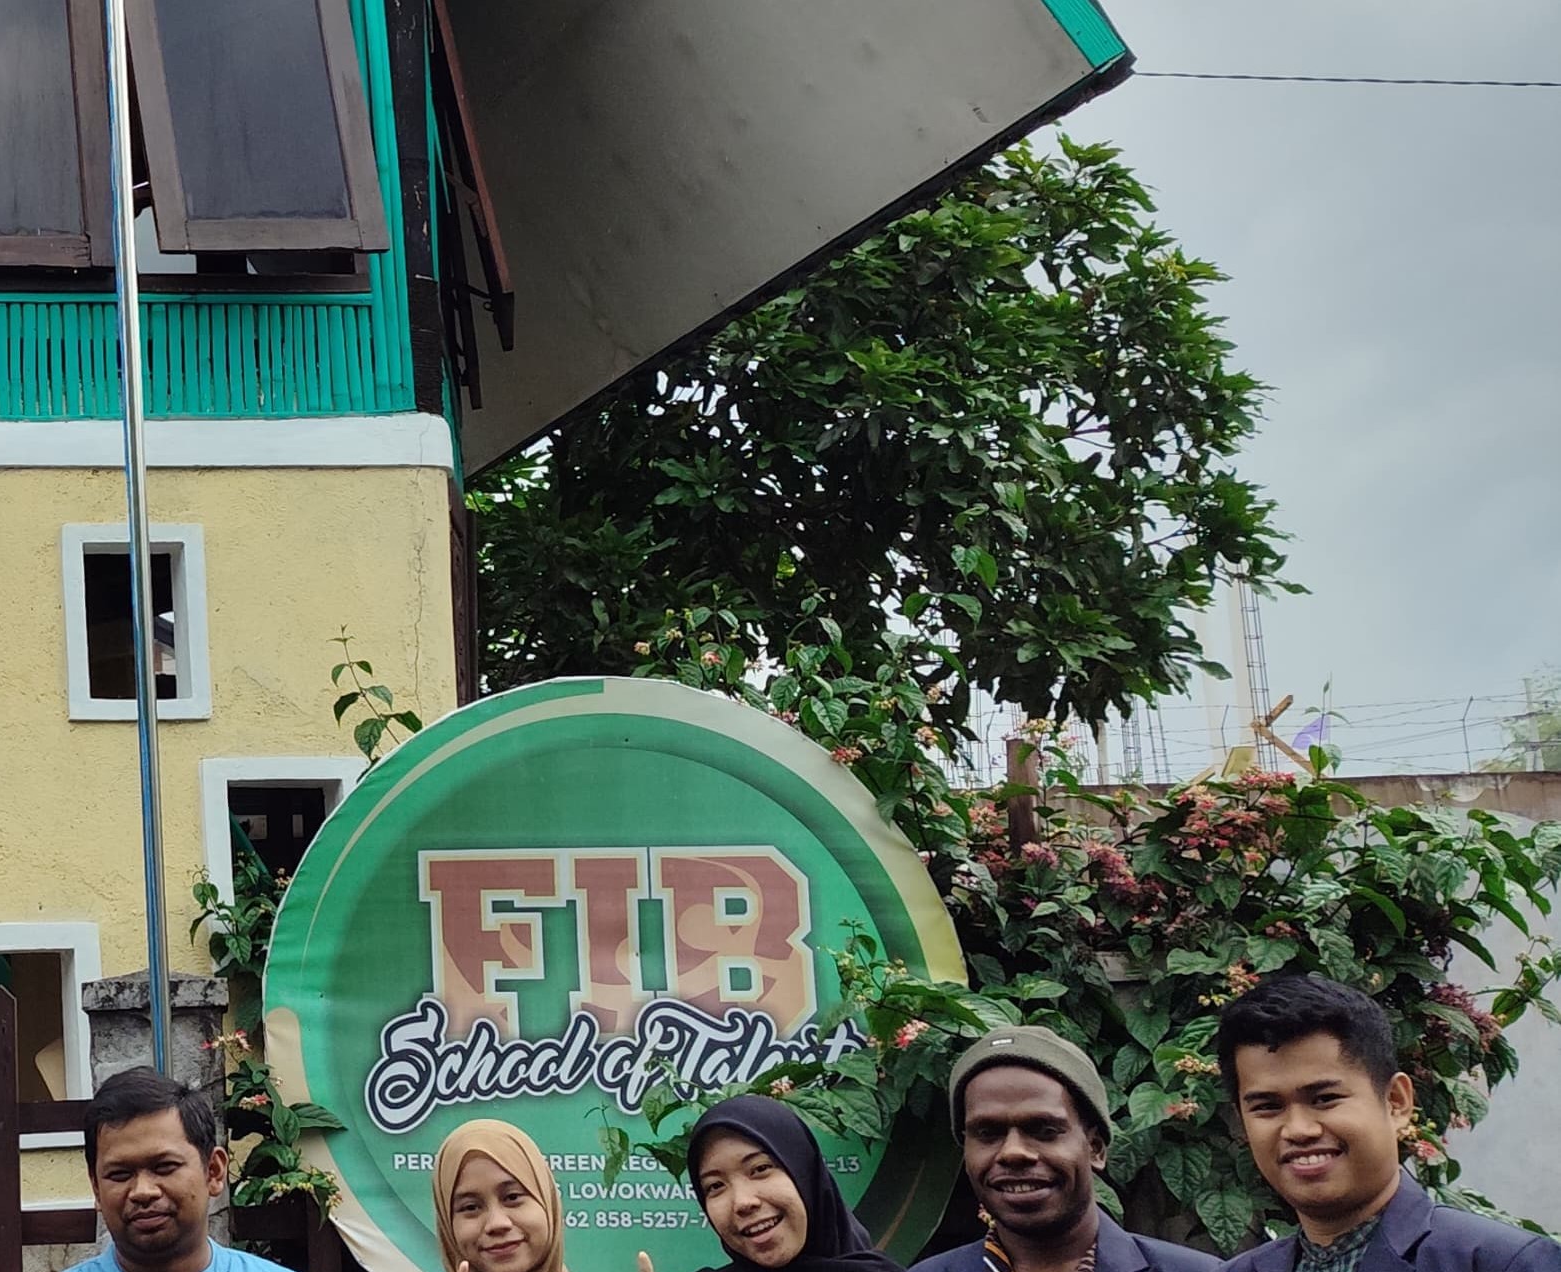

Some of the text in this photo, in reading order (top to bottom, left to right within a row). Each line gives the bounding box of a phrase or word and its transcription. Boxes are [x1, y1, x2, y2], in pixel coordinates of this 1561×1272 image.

[419, 846, 818, 1036] FIB
[367, 999, 596, 1132] School
[595, 1018, 678, 1113] of
[824, 1156, 860, 1173] -13
[563, 1211, 589, 1228] 62
